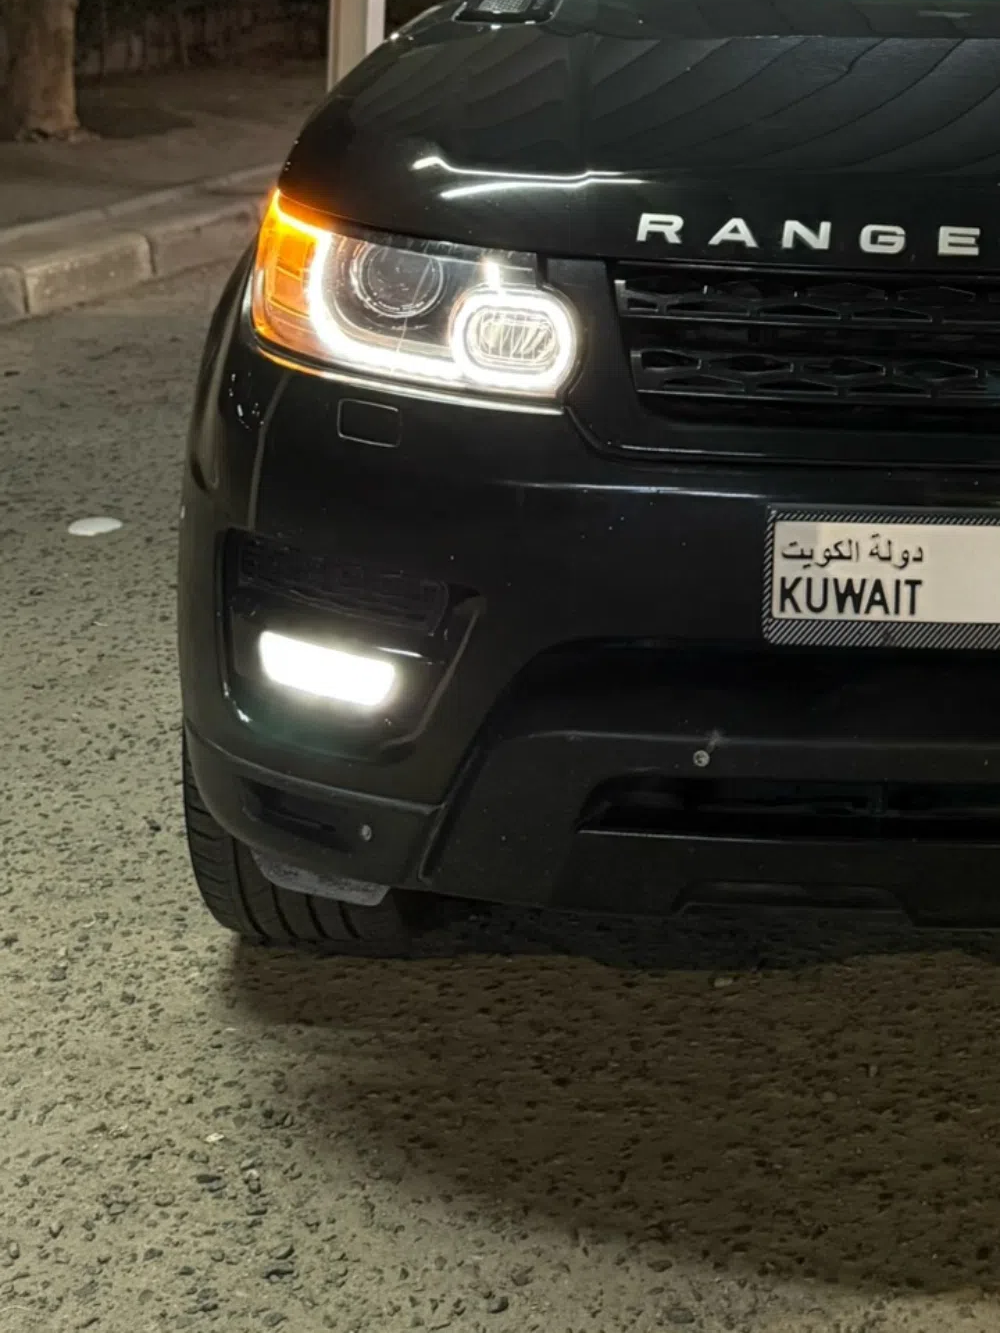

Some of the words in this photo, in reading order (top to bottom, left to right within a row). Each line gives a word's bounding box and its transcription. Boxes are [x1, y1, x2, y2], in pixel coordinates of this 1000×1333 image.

[635, 212, 982, 257] RANGE
[780, 537, 860, 570] الكويت
[868, 533, 925, 570] دولة
[779, 576, 924, 616] KUWAIT
